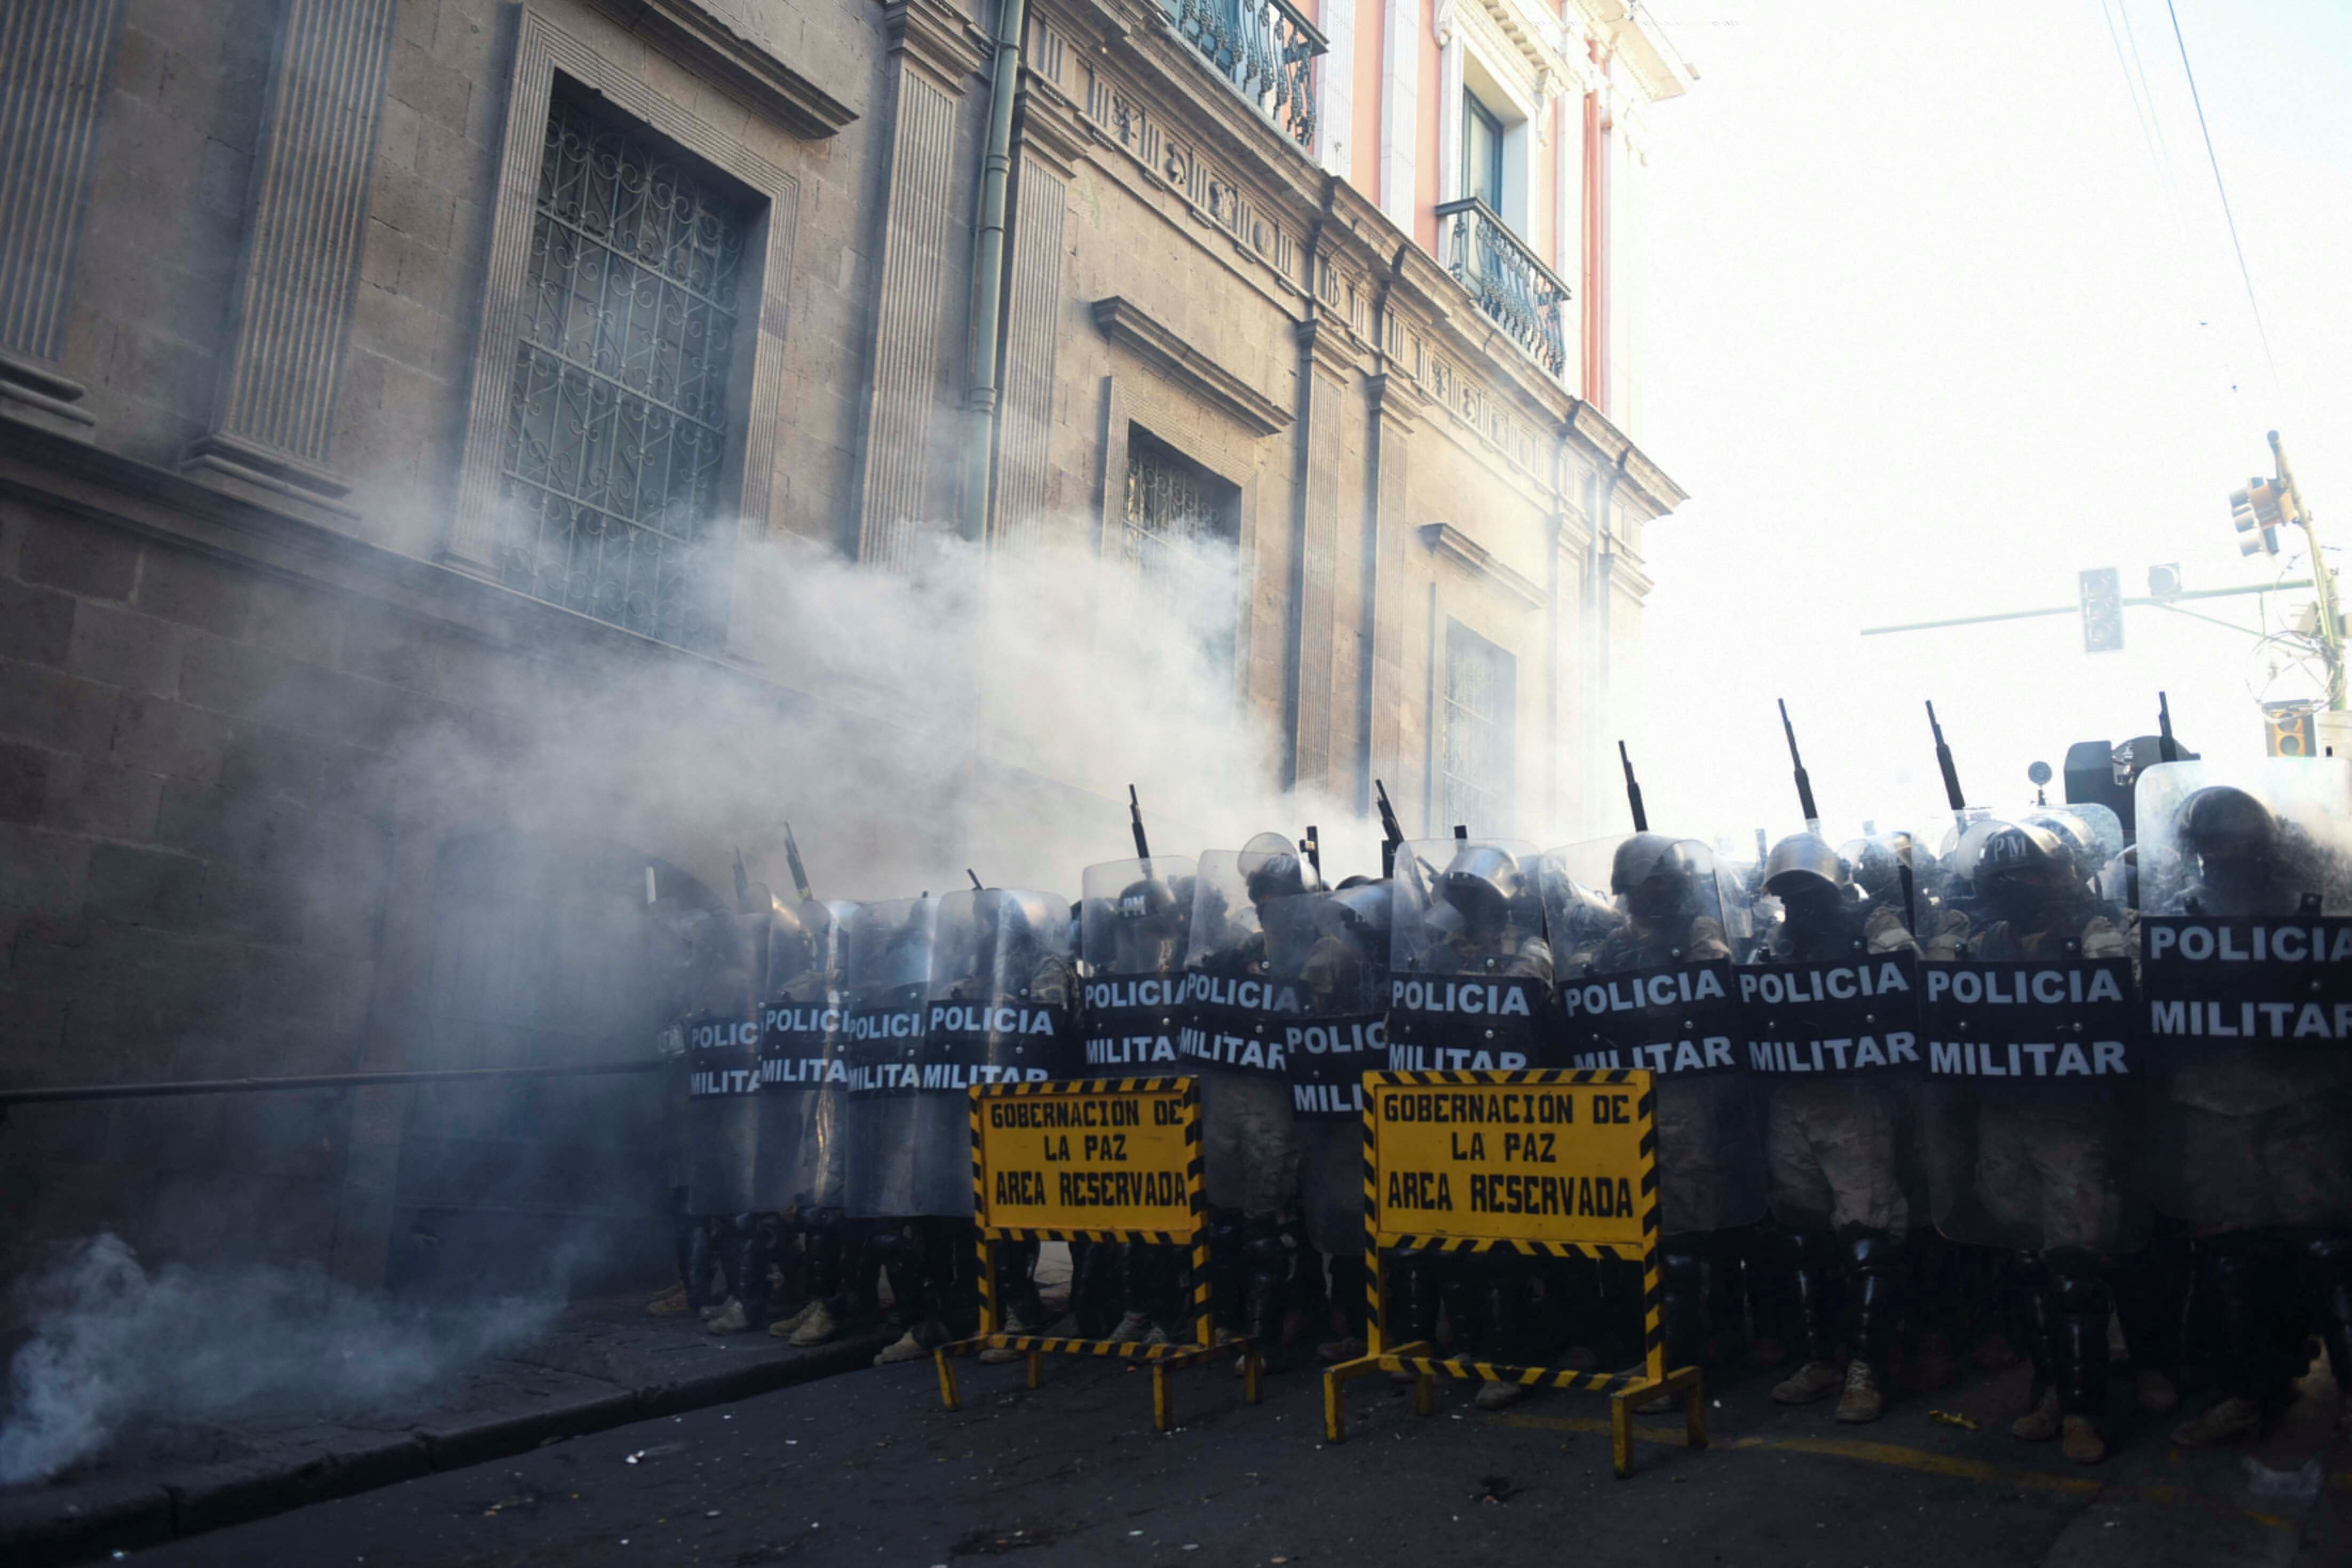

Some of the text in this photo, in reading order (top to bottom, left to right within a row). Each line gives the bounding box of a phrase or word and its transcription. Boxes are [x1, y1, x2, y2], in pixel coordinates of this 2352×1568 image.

[1993, 836, 2026, 862] PM
[2150, 926, 2352, 961] POLICIA
[1187, 973, 1300, 1013] POLICIA
[1392, 980, 1530, 1016] POLICIA
[1565, 969, 1725, 1016] POLICIA
[1739, 962, 1909, 1003] POLICIA
[1927, 969, 2124, 1003] POLICIA
[692, 1022, 763, 1050] POLIC
[765, 1008, 850, 1032] POLICI
[930, 1007, 1055, 1035] POLICIA
[1086, 1035, 1176, 1064] MILITA
[1179, 1027, 1286, 1071] MILITAR
[1286, 1021, 1386, 1054] POLIC
[1748, 1032, 1920, 1071] MILITAR
[761, 1059, 848, 1082] MILITA
[1929, 1041, 2128, 1076] MILITAR
[691, 1070, 760, 1094] MILITA
[849, 1063, 920, 1091] MILITA
[1154, 1099, 1183, 1126] DE
[1294, 1083, 1364, 1111] MILI
[1593, 1095, 1630, 1124] DE
[1044, 1134, 1127, 1161] LA PAZ
[1452, 1131, 1556, 1163] LA PAZ
[996, 1171, 1187, 1206] AREA RESERVADA
[1388, 1171, 1633, 1217] AREA RESERVADA
